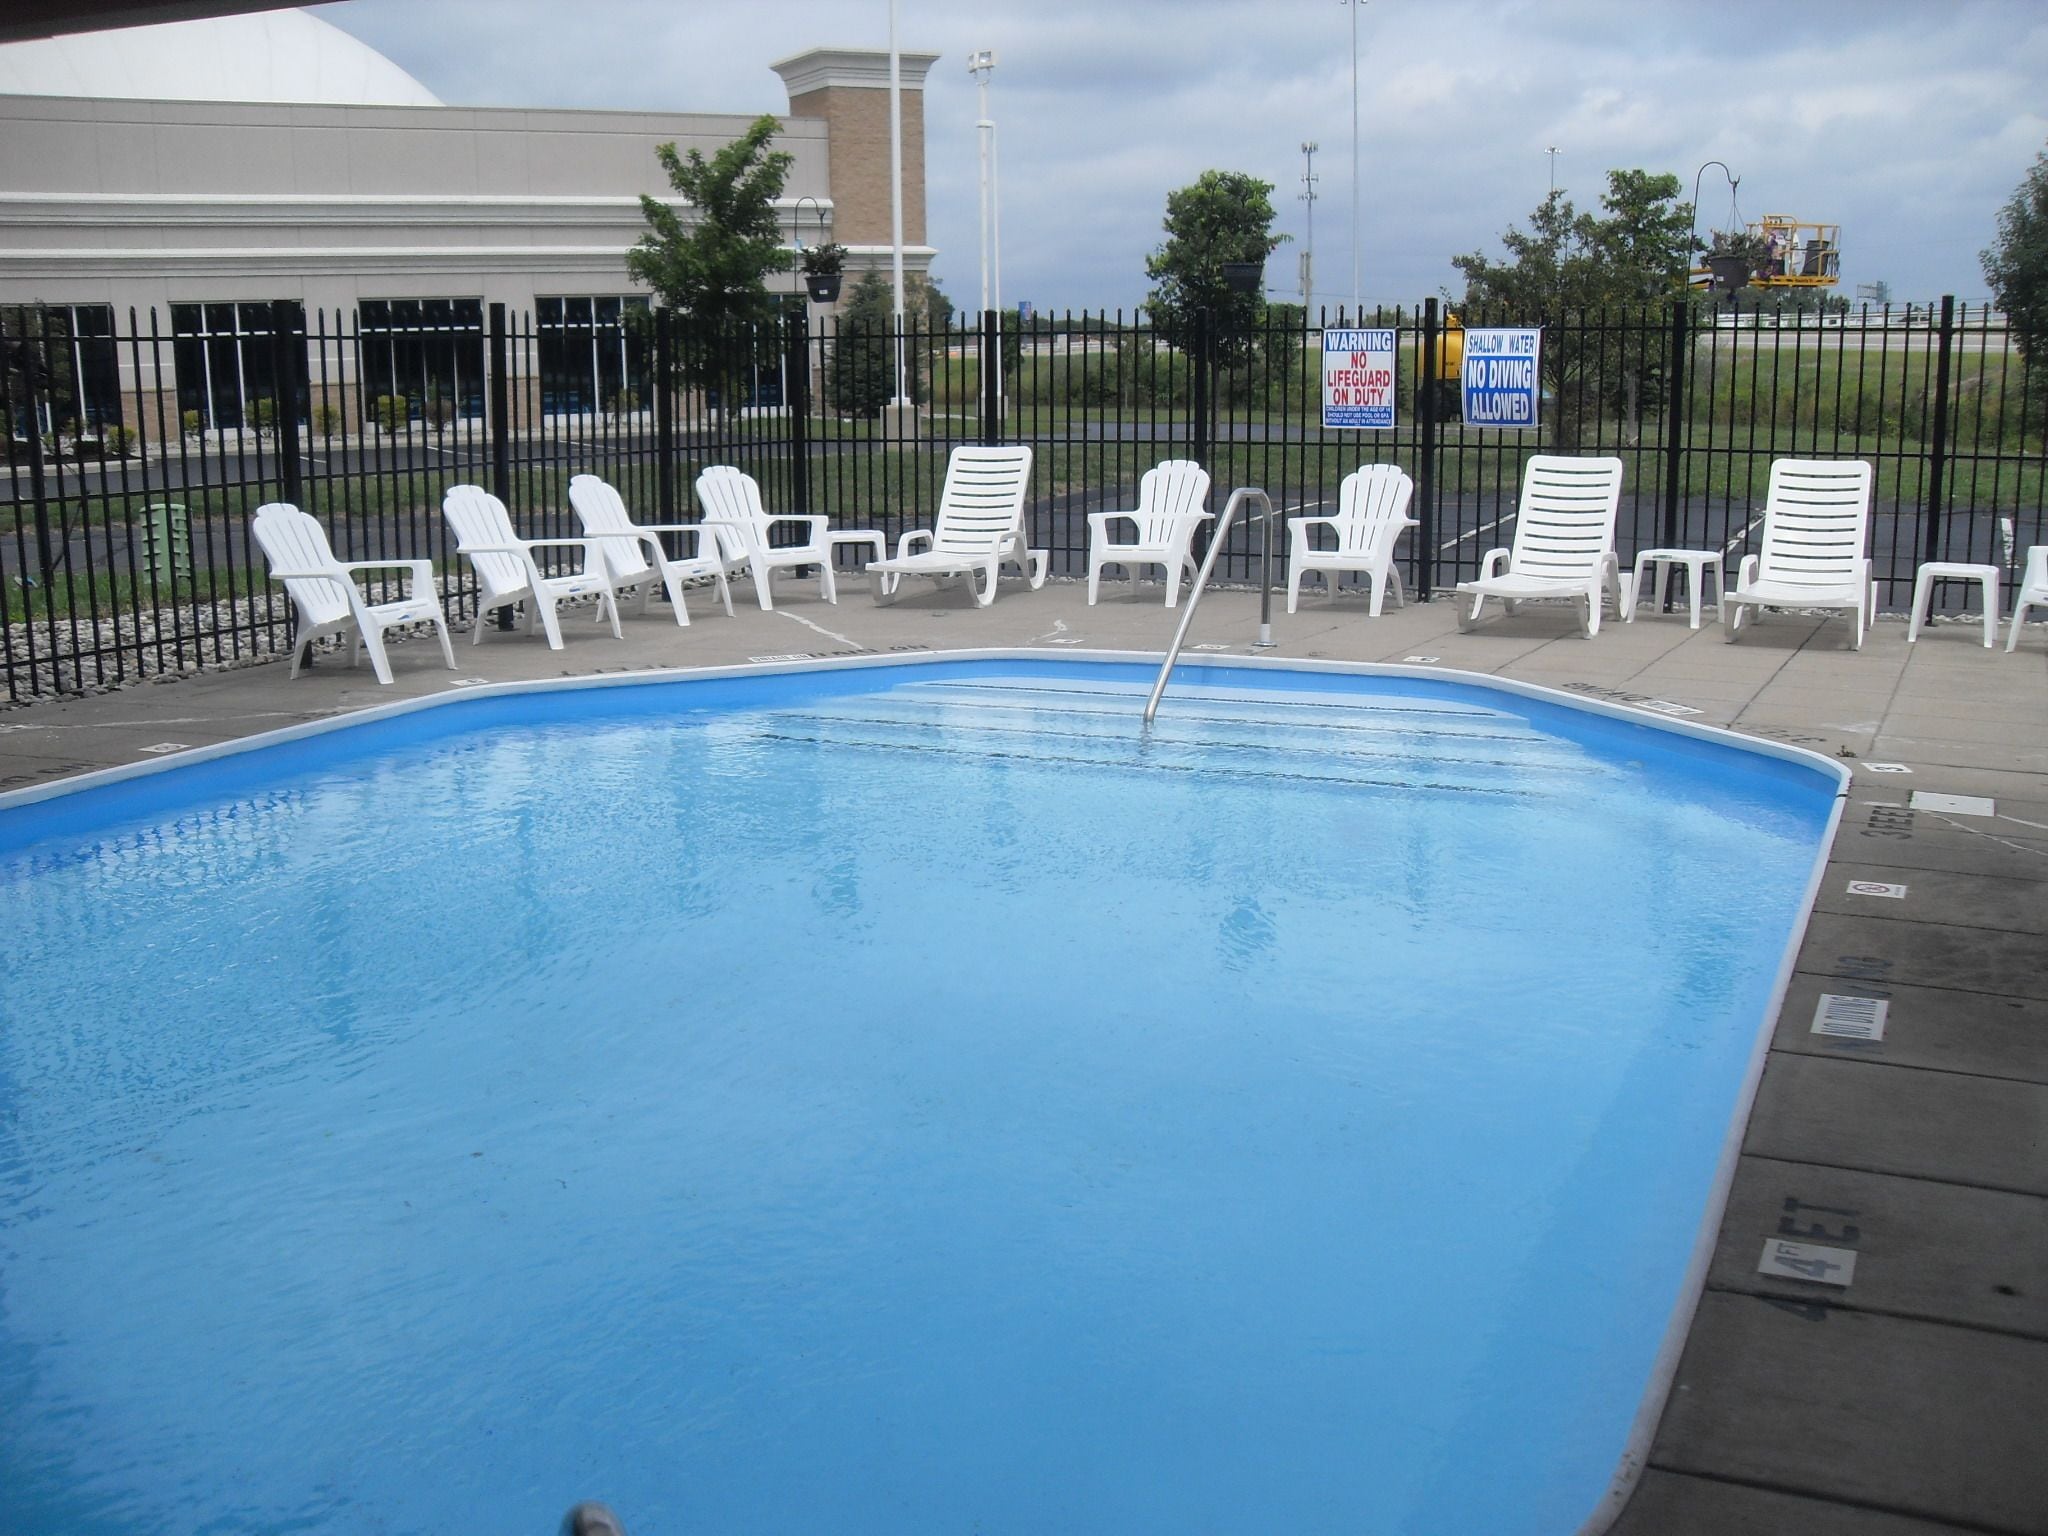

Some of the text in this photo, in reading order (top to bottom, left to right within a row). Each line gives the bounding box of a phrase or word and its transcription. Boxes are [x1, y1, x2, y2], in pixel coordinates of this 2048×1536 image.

[1328, 332, 1391, 351] WARNING
[1468, 335, 1535, 354] SHALLOW WATER
[1351, 352, 1367, 369] NO
[1327, 370, 1390, 387] LIFEGUARD
[1468, 360, 1532, 389] NO DIVING
[1333, 388, 1384, 405] ON DUTY
[1472, 392, 1529, 421] ALLOWED
[1875, 764, 1904, 772] 3
[1860, 829, 1913, 840] 3
[1821, 996, 1878, 1038] NO DIVING
[1773, 1242, 1841, 1279] 4 FT
